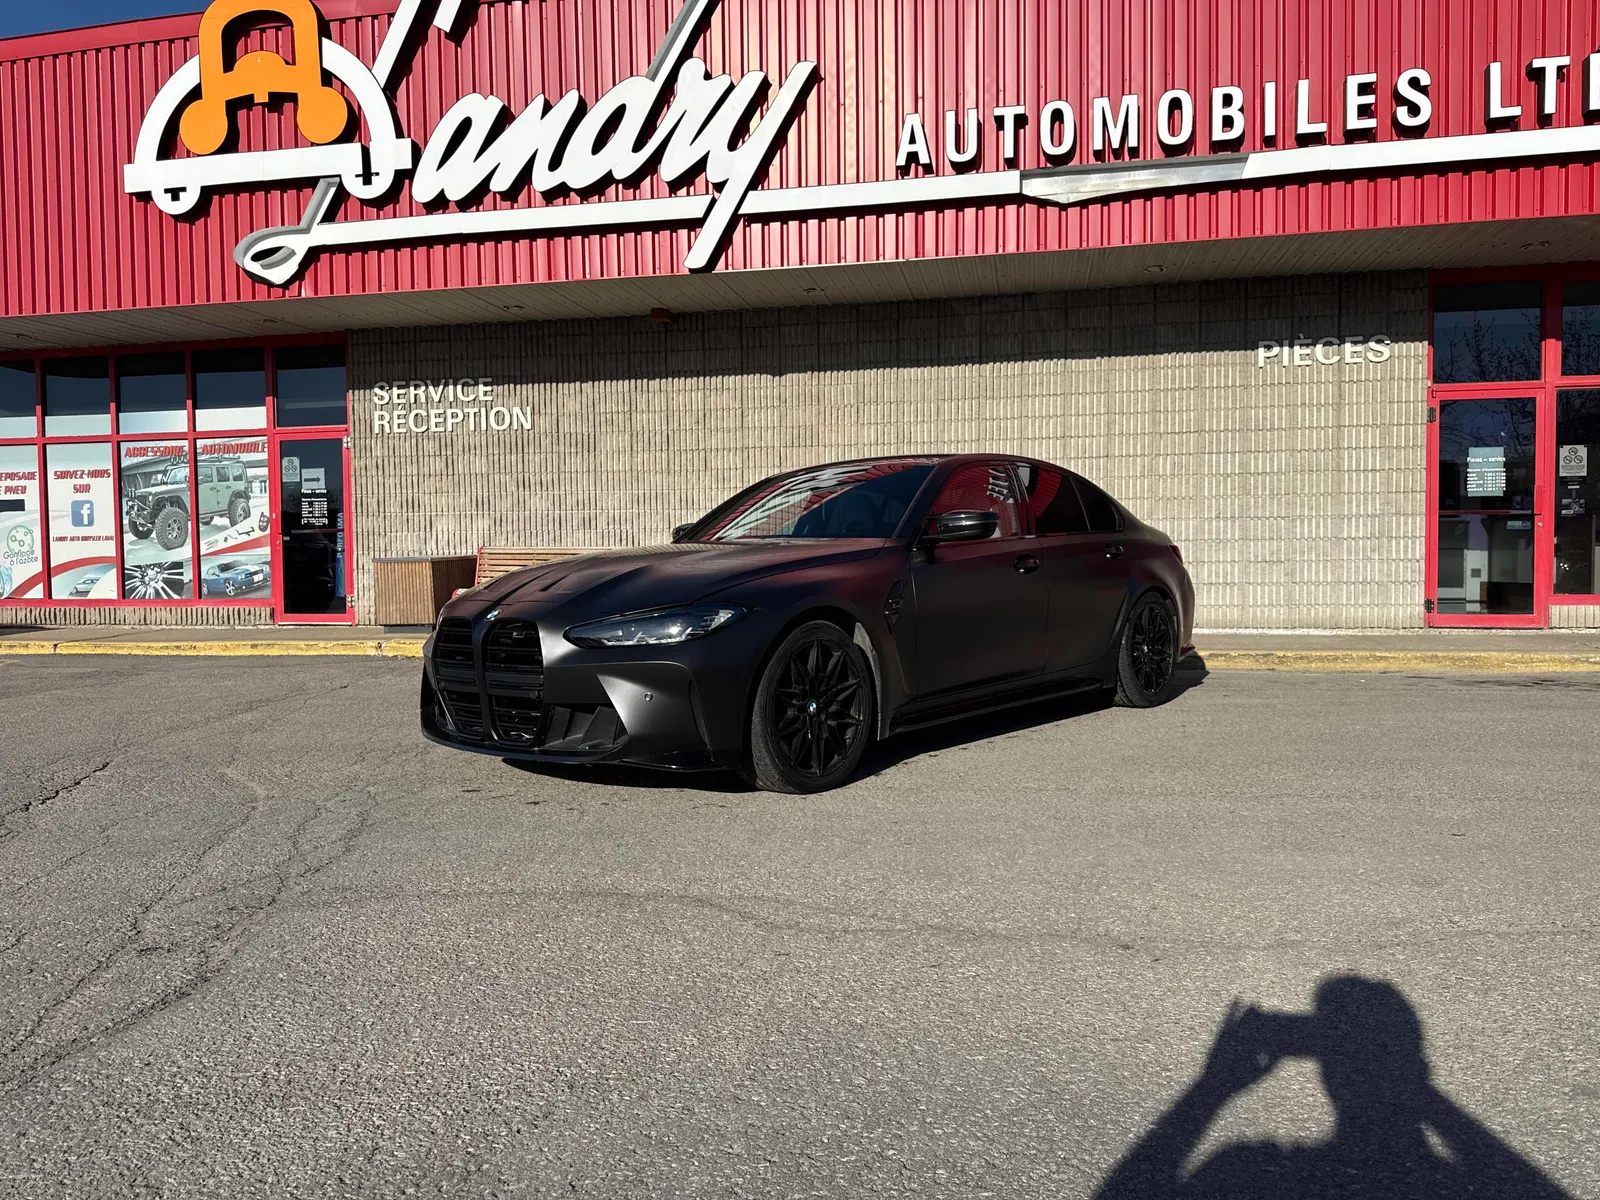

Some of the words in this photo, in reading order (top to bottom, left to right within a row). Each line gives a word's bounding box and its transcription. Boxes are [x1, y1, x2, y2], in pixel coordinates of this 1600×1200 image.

[895, 67, 1432, 166] AUTOMOBILES
[1257, 333, 1391, 368] PIÈCES
[373, 377, 493, 404] SERVICE
[373, 405, 532, 433] RÉCEPTION
[53, 469, 111, 480] SUIVEZ-NOUS
[72, 483, 91, 494] SUR
